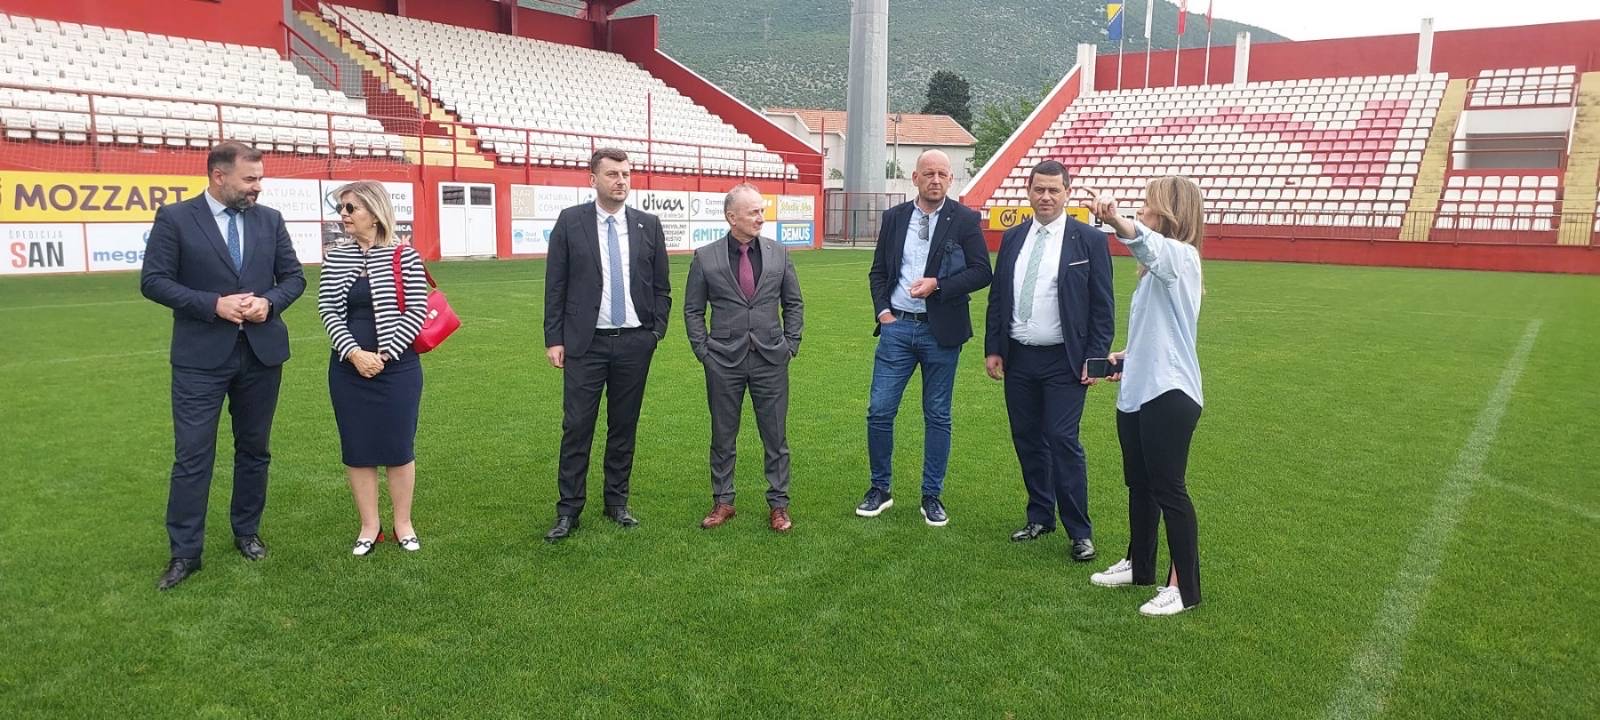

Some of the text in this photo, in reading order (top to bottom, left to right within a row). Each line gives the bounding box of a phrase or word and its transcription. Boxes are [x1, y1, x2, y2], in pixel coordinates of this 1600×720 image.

[14, 183, 188, 211] MOZZART
[642, 193, 684, 211] divan
[693, 228, 725, 242] AMITE
[780, 227, 811, 241] DEMUS
[10, 241, 65, 268] SAN
[93, 250, 146, 264] mega
